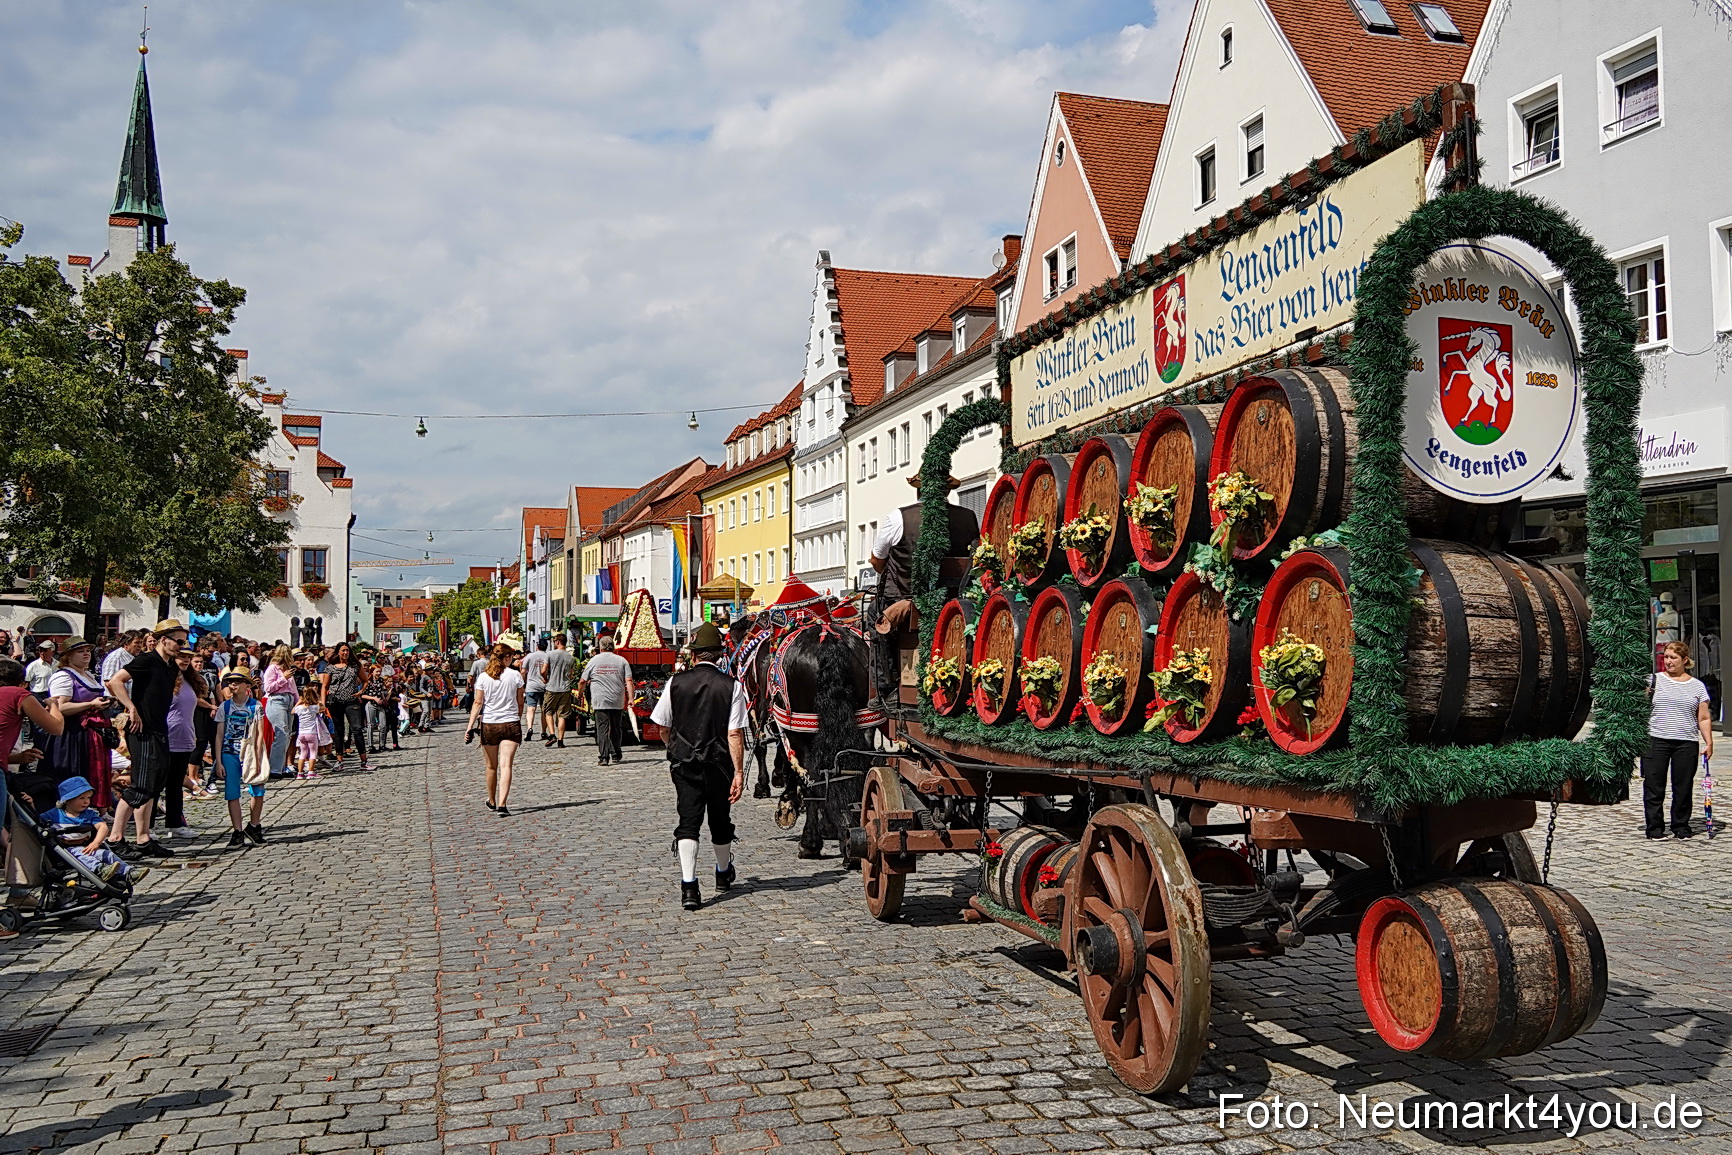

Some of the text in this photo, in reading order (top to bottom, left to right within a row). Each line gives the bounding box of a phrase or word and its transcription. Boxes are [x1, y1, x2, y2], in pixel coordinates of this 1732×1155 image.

[1220, 193, 1343, 302] Lengenfeld
[1194, 251, 1368, 363] das Bier von heut
[1497, 285, 1556, 339] Bräu
[1035, 307, 1136, 390] Winkler Bräu
[1407, 356, 1425, 372] eit
[1047, 386, 1072, 424] 1628
[1073, 371, 1097, 413] und
[1098, 349, 1150, 403] dennoch
[1526, 371, 1559, 389] 1628
[1425, 437, 1528, 479] Lengenfeld
[1658, 461, 1690, 469] FASHION
